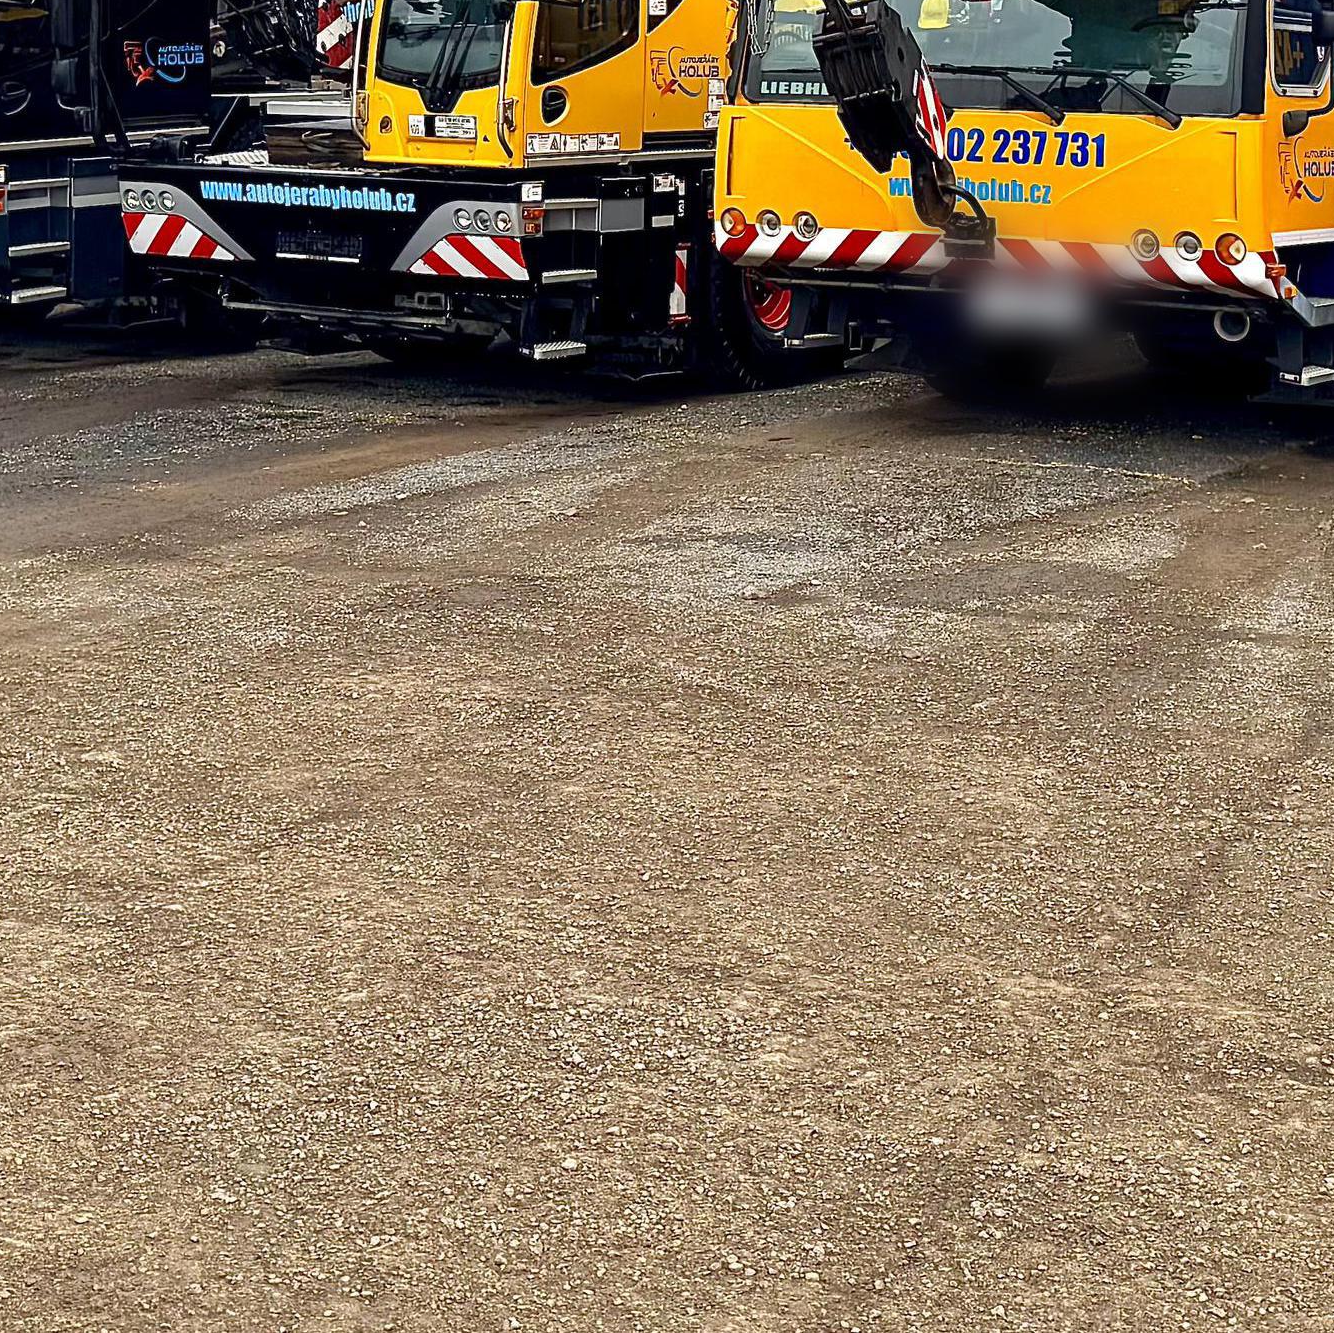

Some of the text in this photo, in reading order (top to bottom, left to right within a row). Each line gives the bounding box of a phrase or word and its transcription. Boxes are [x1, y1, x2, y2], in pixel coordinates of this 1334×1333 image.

[158, 53, 204, 66] HOLUB
[679, 66, 720, 77] HOLUB
[760, 81, 829, 96] LIEBH
[947, 127, 984, 162] 02
[992, 129, 1049, 166] 237
[1055, 131, 1106, 167] 731
[200, 180, 417, 213] www.autojerabyholub.cz
